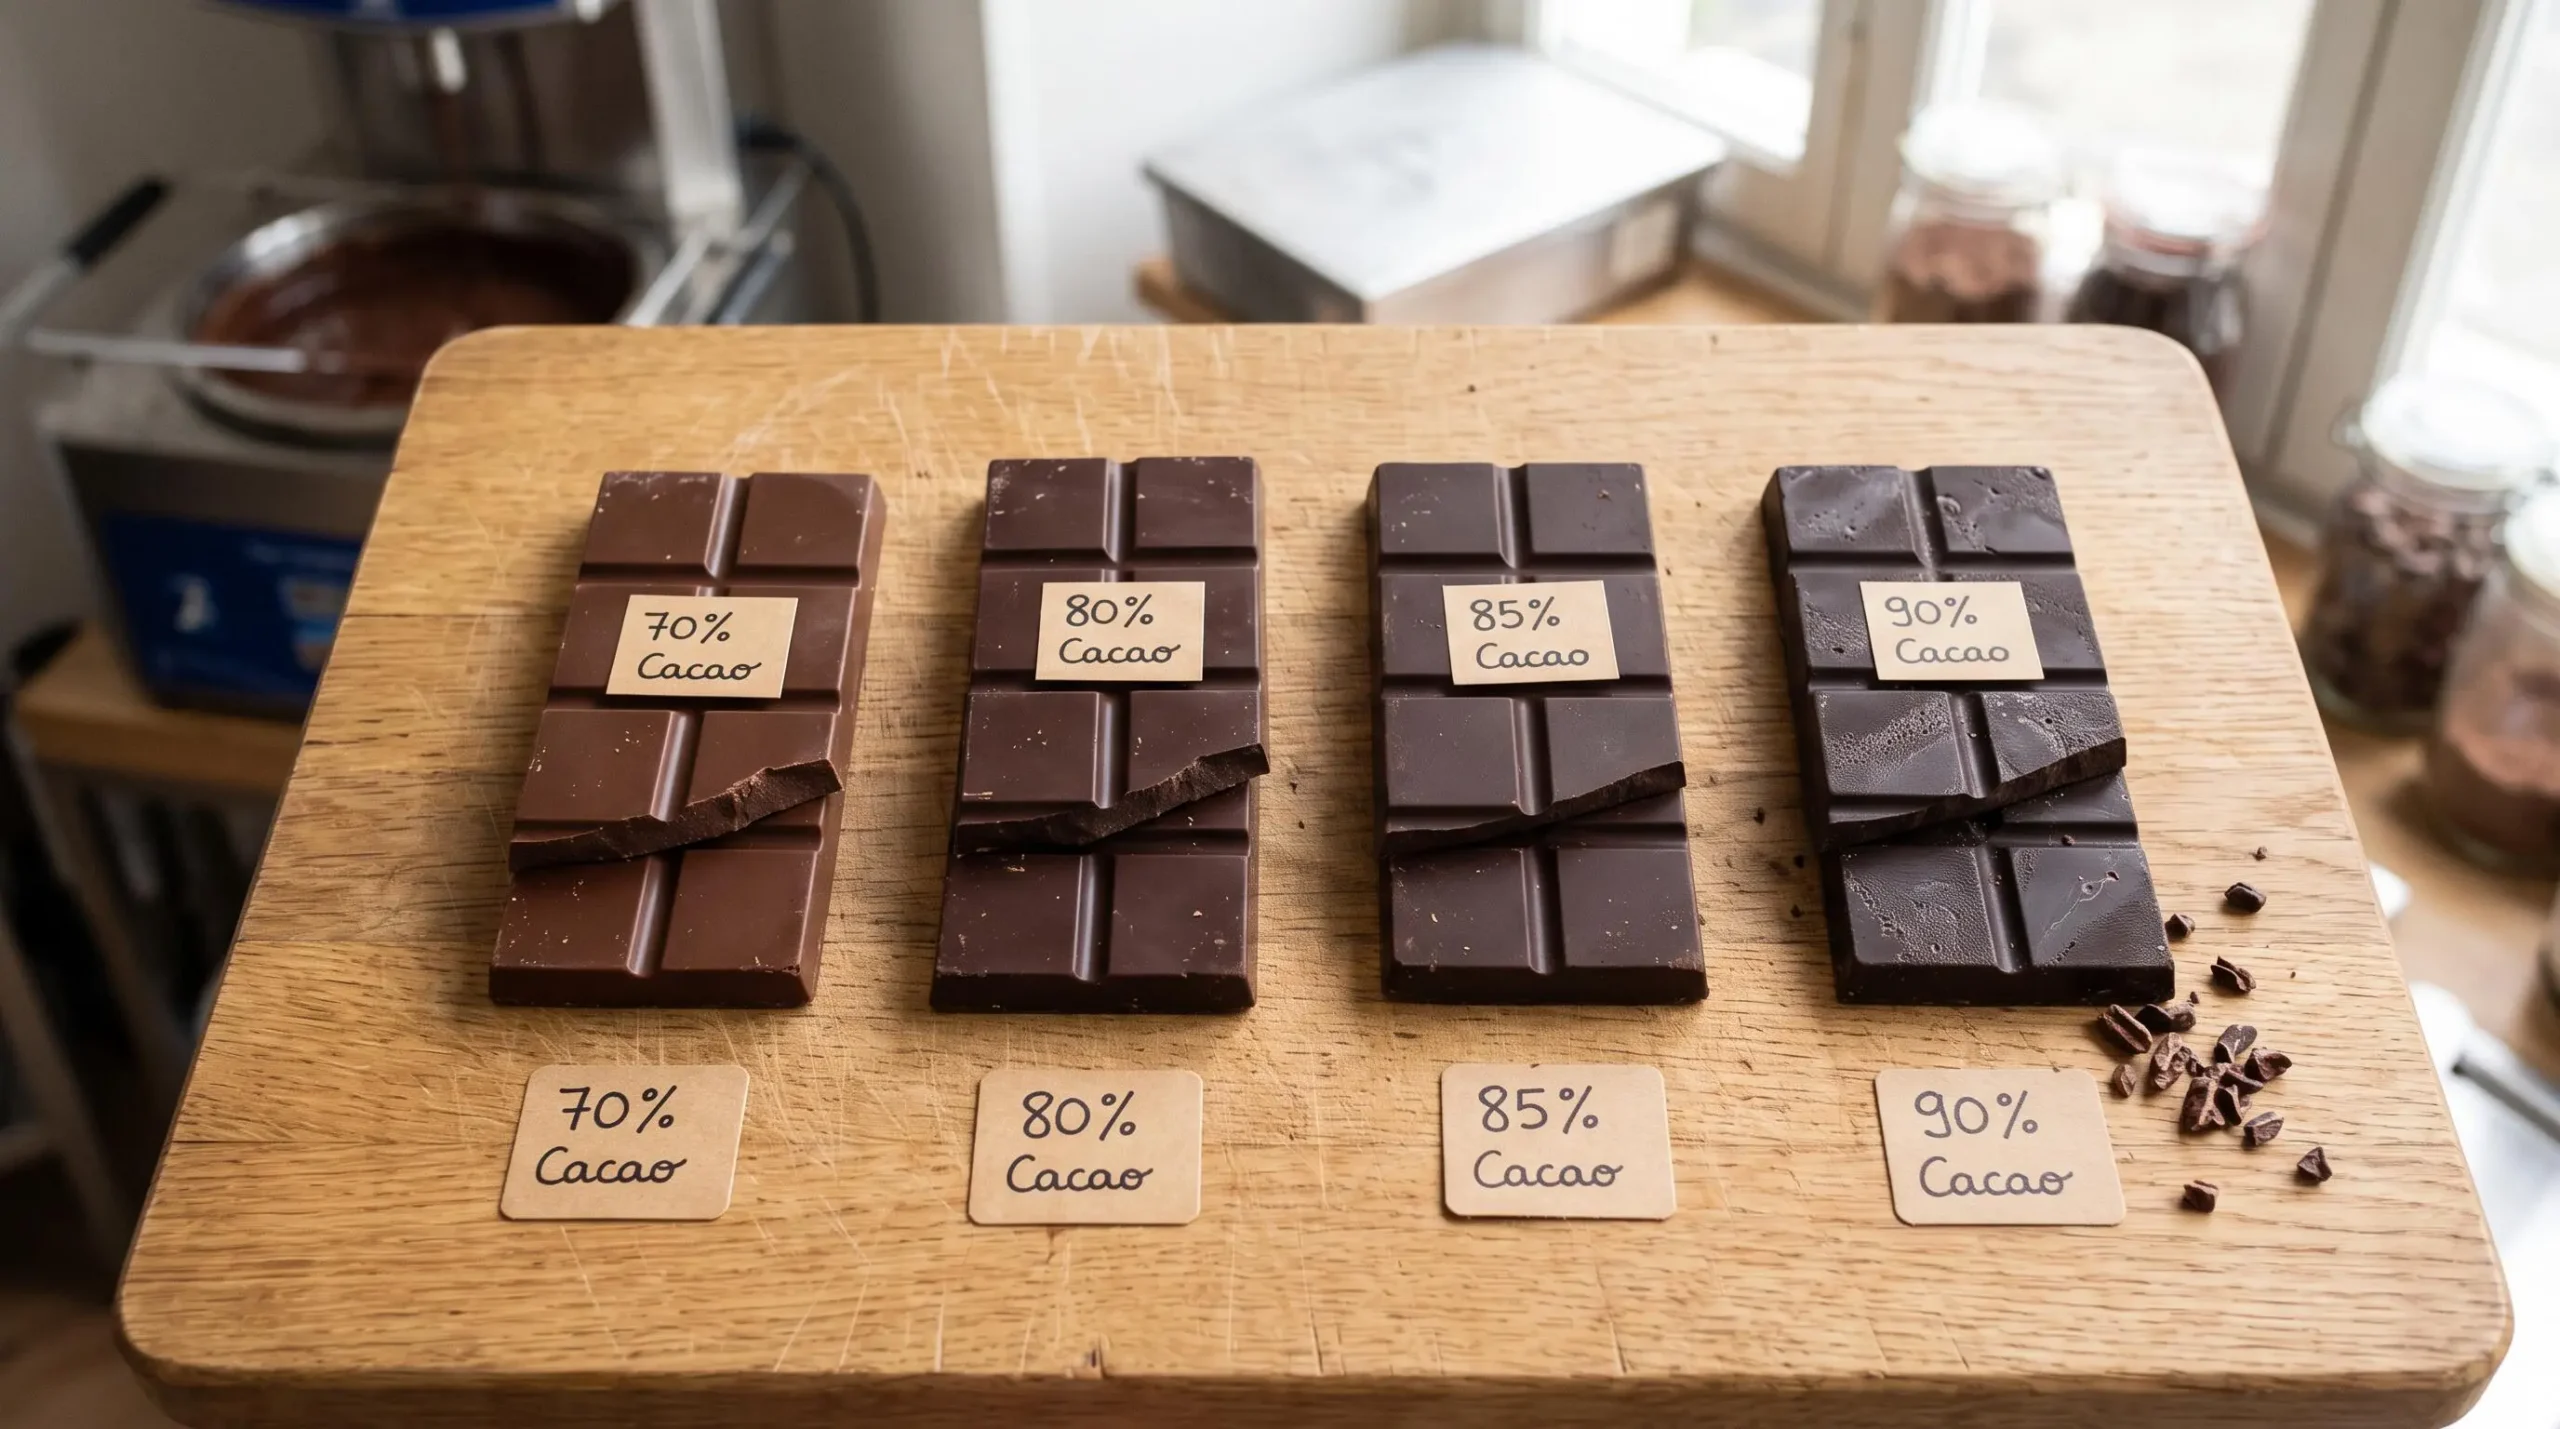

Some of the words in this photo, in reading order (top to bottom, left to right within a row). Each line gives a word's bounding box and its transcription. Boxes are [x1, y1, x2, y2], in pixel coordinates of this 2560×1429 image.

[645, 611, 734, 645] 70%
[1065, 593, 1154, 629] 80%
[1469, 594, 1561, 632] 85%
[1884, 595, 1979, 629] 90%
[636, 652, 763, 682] Cacao
[1058, 636, 1182, 665] Cacao
[1475, 641, 1590, 671] Cacao
[1895, 636, 2011, 665] Cacao
[558, 1084, 677, 1135] 70%
[1022, 1089, 1137, 1142] 80%
[1478, 1084, 1600, 1135] 85%
[1913, 1088, 2040, 1140] 90%
[535, 1145, 688, 1187] Cacao
[1005, 1153, 1154, 1195] Cacao
[1473, 1149, 1625, 1190] Cacao
[1919, 1154, 2074, 1198] Cacao
